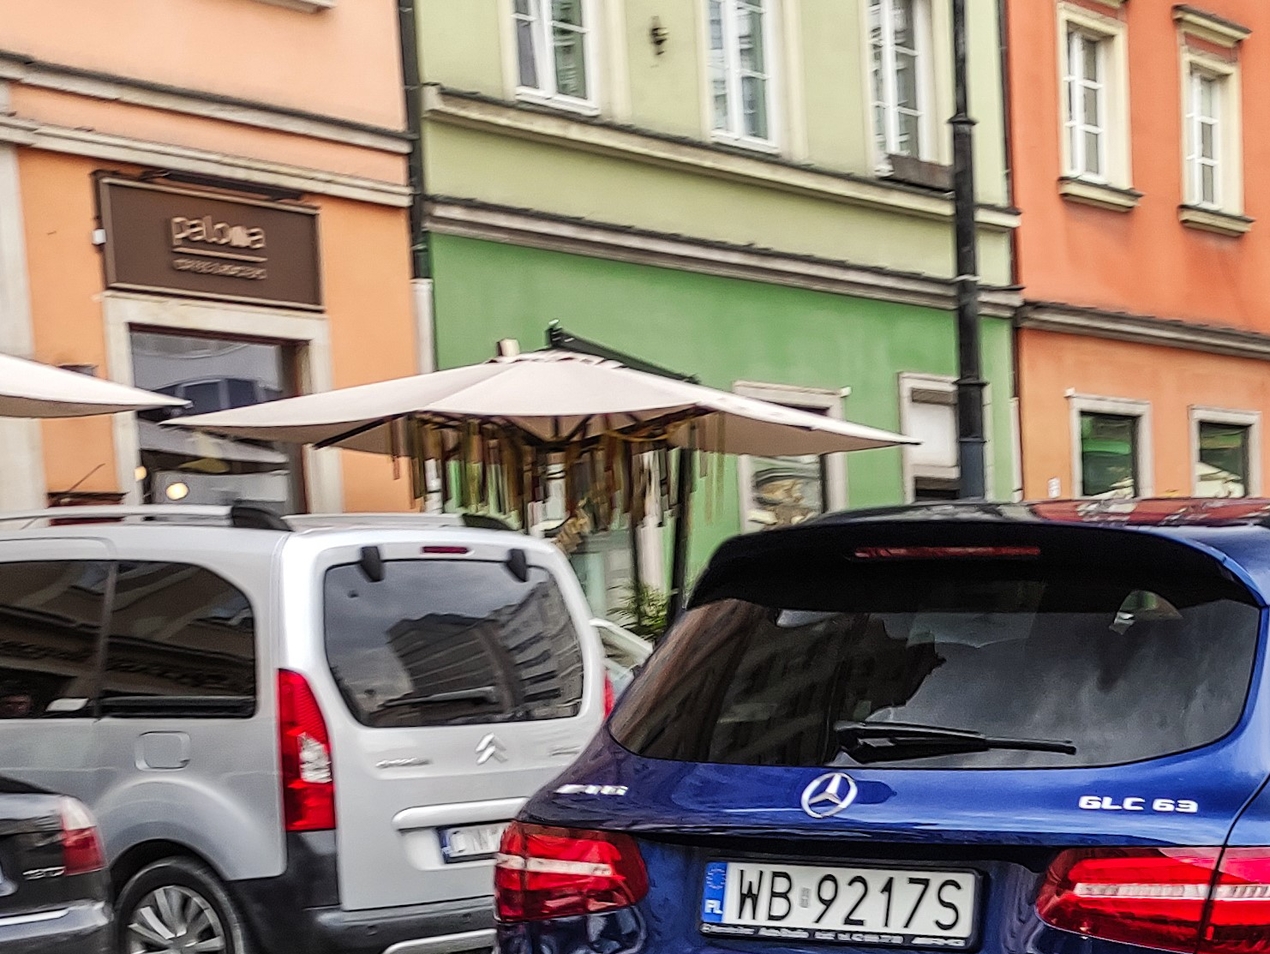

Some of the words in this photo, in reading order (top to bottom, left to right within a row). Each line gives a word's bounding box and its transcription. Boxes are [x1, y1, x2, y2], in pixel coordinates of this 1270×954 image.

[1078, 795, 1146, 811] GLC
[1152, 798, 1199, 813] 63
[704, 899, 723, 914] PL
[737, 869, 793, 922] WB
[812, 873, 963, 931] 9217S
